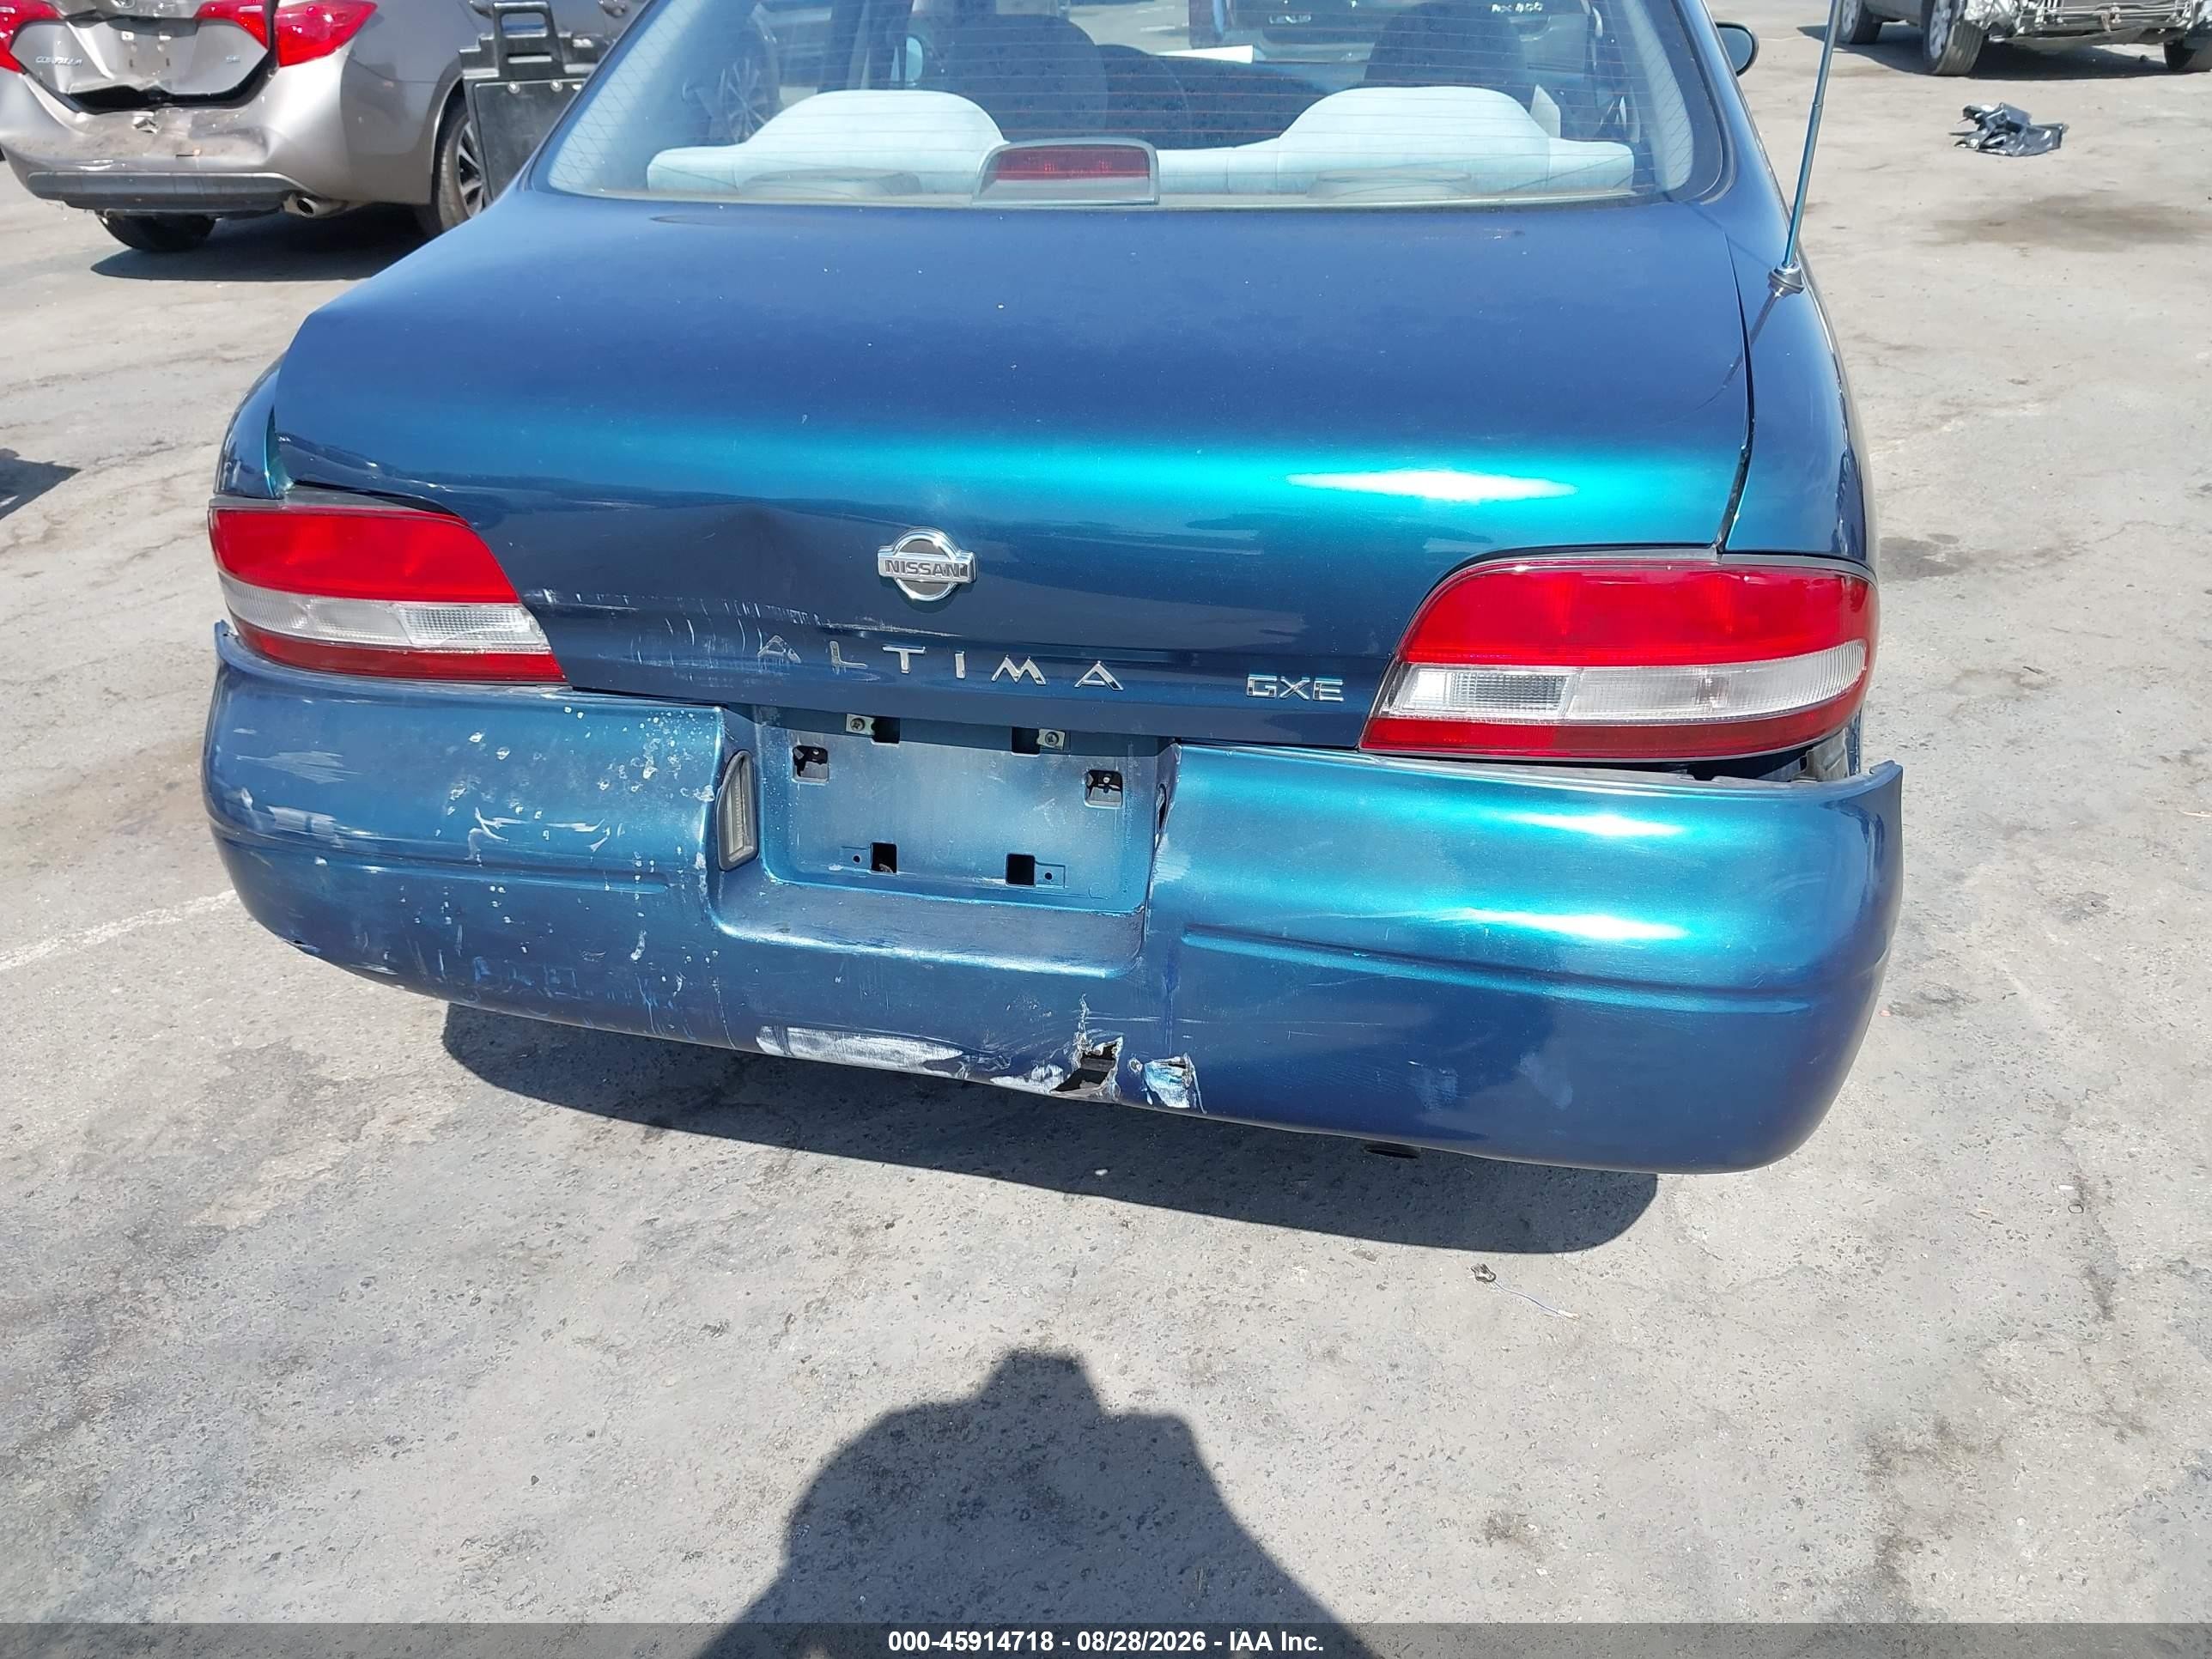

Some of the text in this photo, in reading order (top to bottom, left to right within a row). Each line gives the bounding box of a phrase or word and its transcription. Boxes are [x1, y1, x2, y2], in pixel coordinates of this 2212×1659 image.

[884, 558, 969, 579] NISSAN
[756, 634, 1125, 691] ALTIMA
[1246, 674, 1345, 702] GXE
